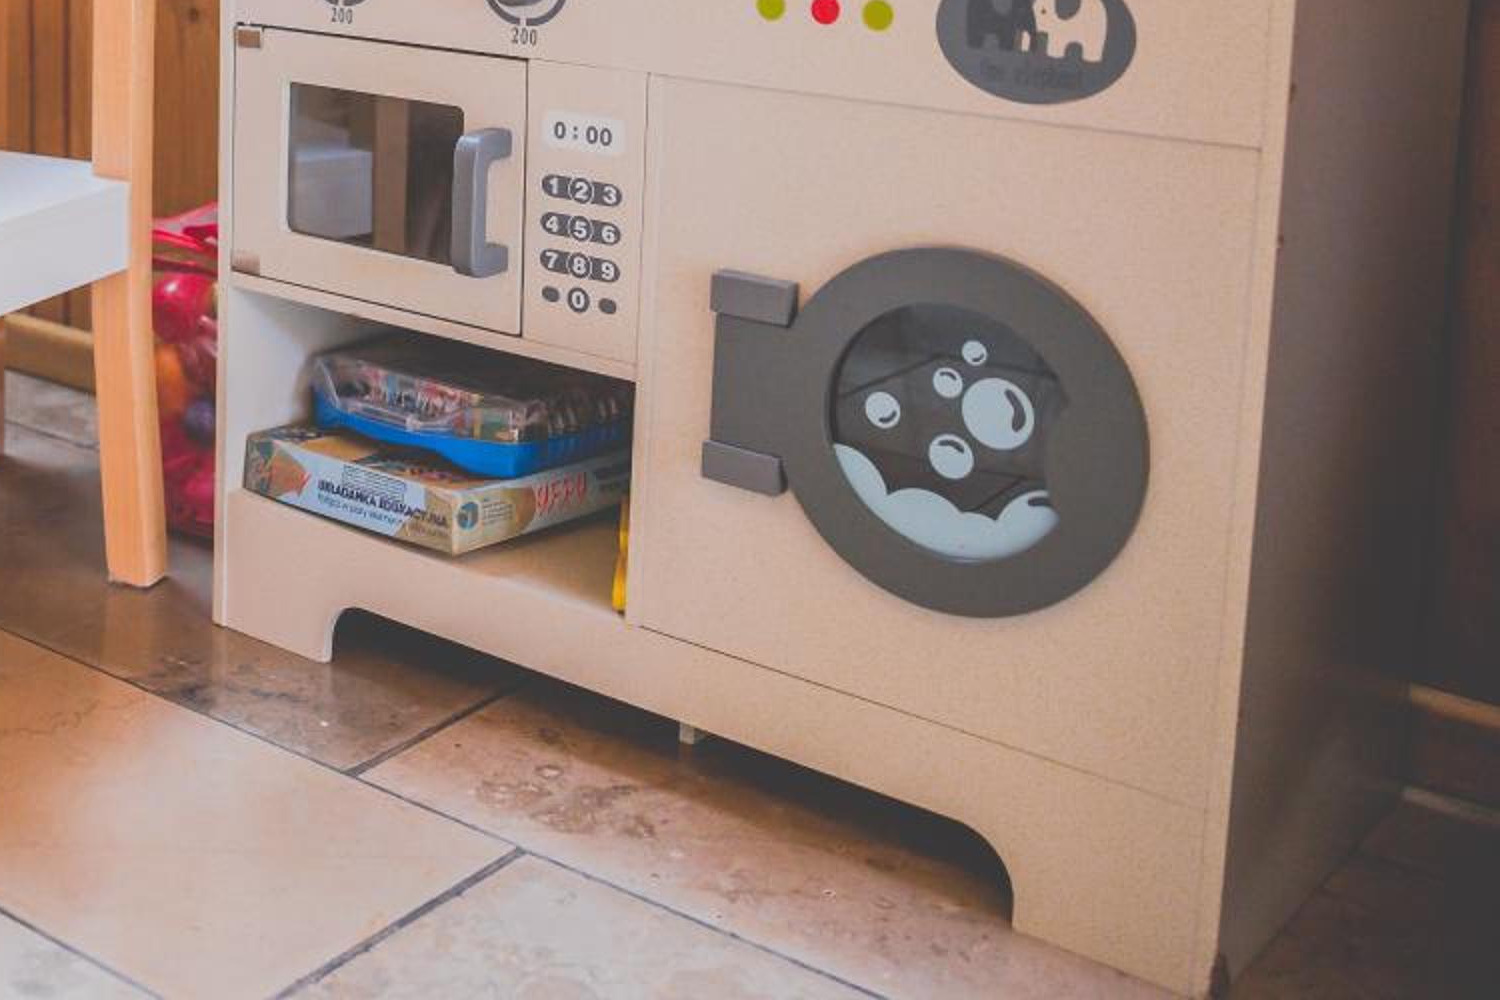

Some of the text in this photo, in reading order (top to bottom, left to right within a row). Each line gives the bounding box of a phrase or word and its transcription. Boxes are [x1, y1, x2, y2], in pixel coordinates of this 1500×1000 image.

[331, 7, 353, 25] 200
[510, 26, 538, 46] 200
[549, 177, 617, 205] 1 2 3
[545, 215, 616, 243] 4 5 6
[545, 251, 615, 281] 7 8 9
[571, 291, 586, 310] 0
